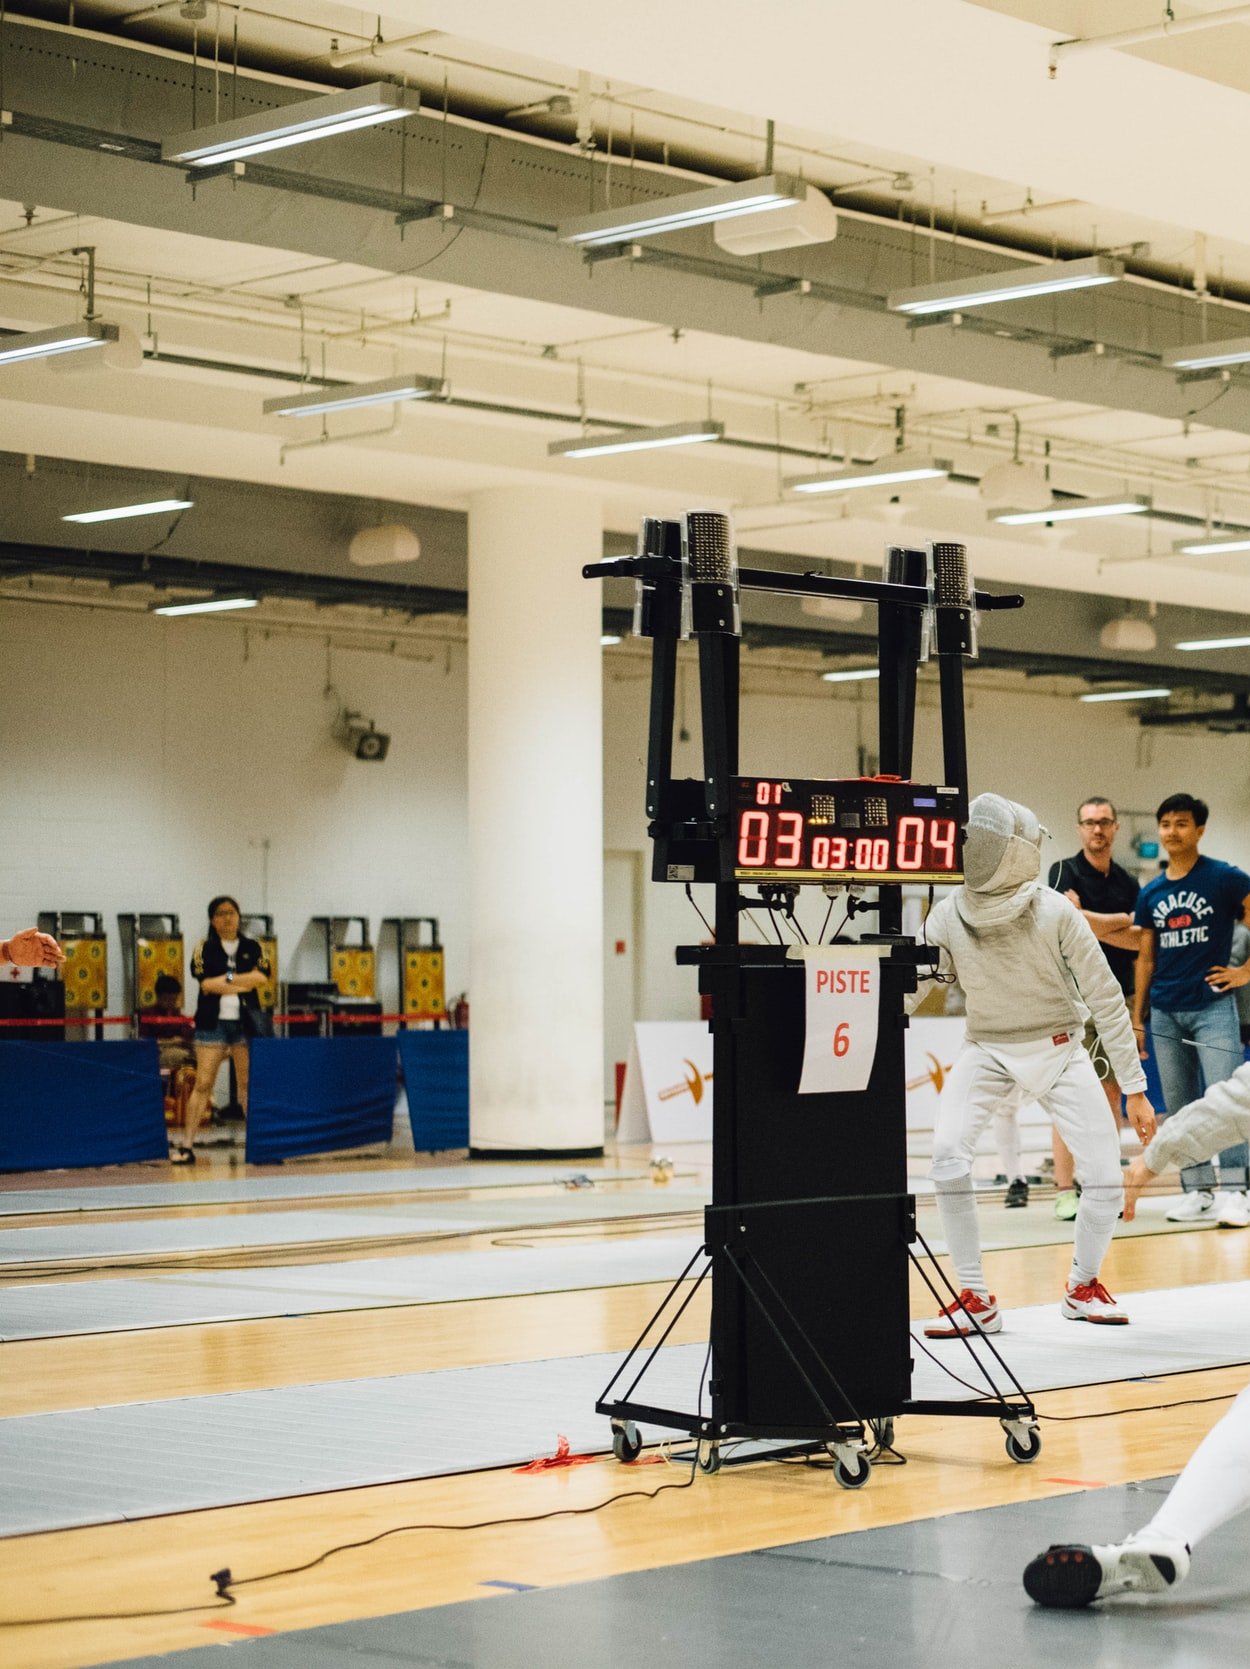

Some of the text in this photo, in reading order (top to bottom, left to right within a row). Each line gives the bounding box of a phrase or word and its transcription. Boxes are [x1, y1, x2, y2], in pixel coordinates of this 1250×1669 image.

[738, 811, 803, 866] 03
[812, 837, 889, 870] 03:00
[896, 817, 955, 869] 04
[1152, 891, 1214, 928] SYRACUSE
[1160, 926, 1209, 948] ATHLETIC
[816, 970, 870, 994] PISTE
[833, 1022, 850, 1057] 6
